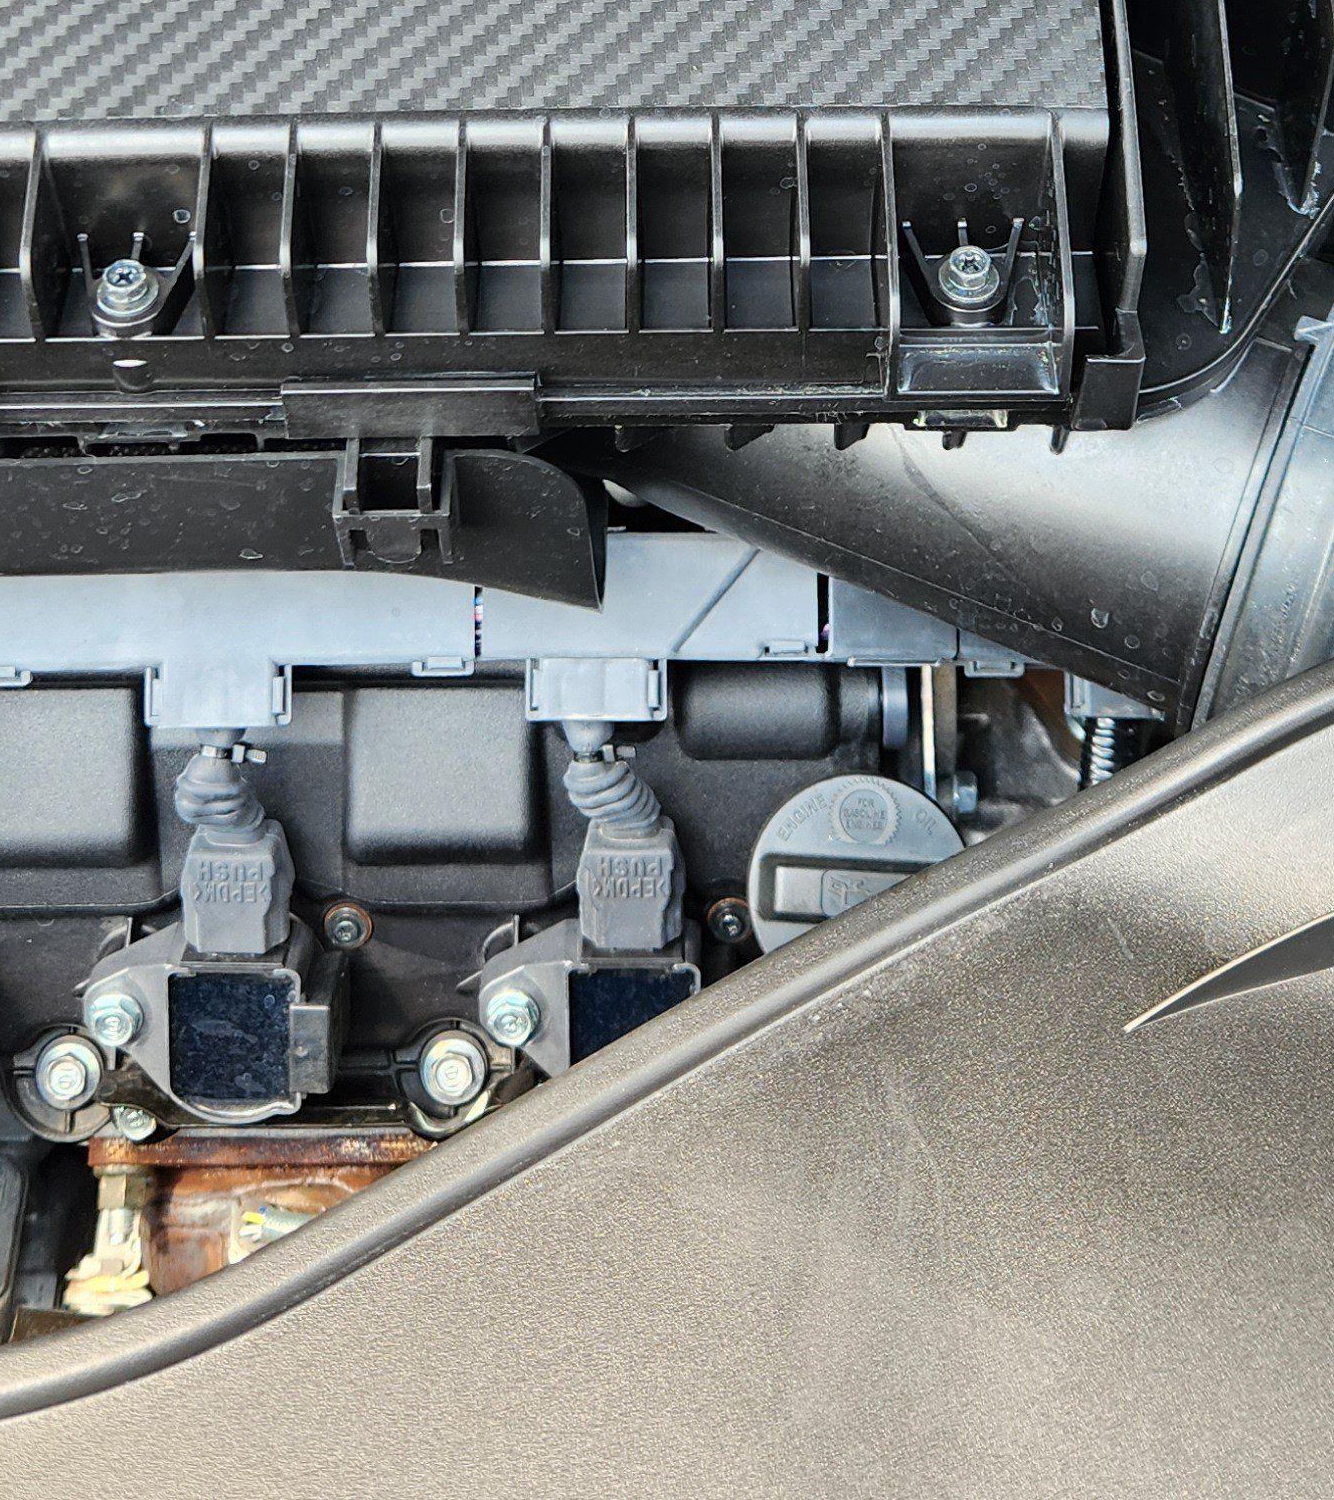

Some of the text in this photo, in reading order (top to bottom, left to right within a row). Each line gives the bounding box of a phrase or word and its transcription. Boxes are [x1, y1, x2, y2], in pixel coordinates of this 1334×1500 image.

[775, 793, 937, 841] ENGINE OIL
[199, 860, 264, 882] PUSH
[599, 855, 663, 877] PUSH
